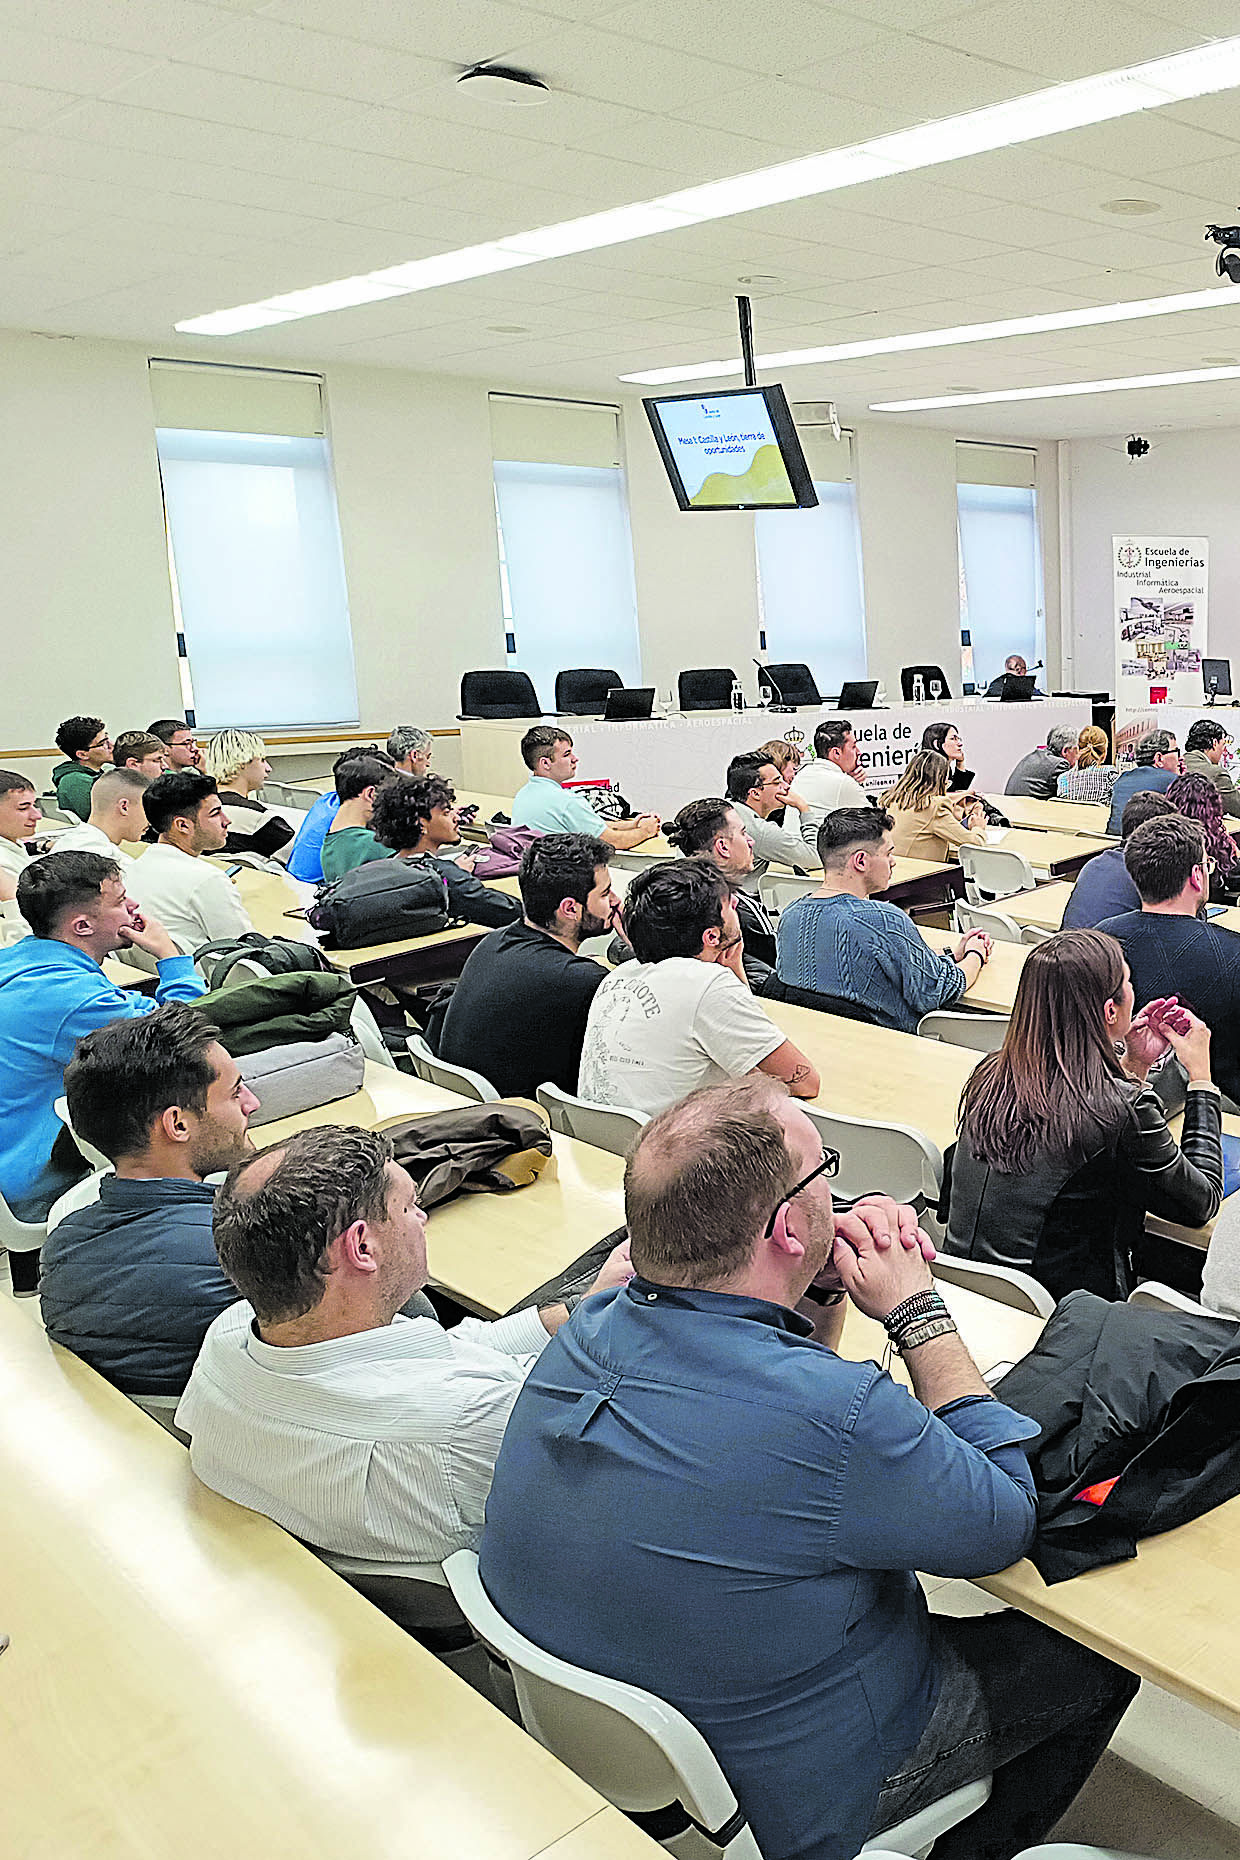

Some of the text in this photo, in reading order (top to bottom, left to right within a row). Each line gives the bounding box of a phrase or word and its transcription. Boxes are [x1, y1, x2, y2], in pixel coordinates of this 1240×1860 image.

[678, 436, 694, 445] Mesa
[698, 434, 719, 444] Castilla
[757, 431, 766, 440] de
[704, 444, 746, 455] oportunidades
[1145, 547, 1190, 556] Escuela de
[1145, 556, 1205, 569] Ingenierías
[1136, 578, 1179, 586] Informática
[1158, 586, 1204, 595] Aeroespacial
[854, 722, 912, 742] uela de
[860, 743, 918, 768] enierí
